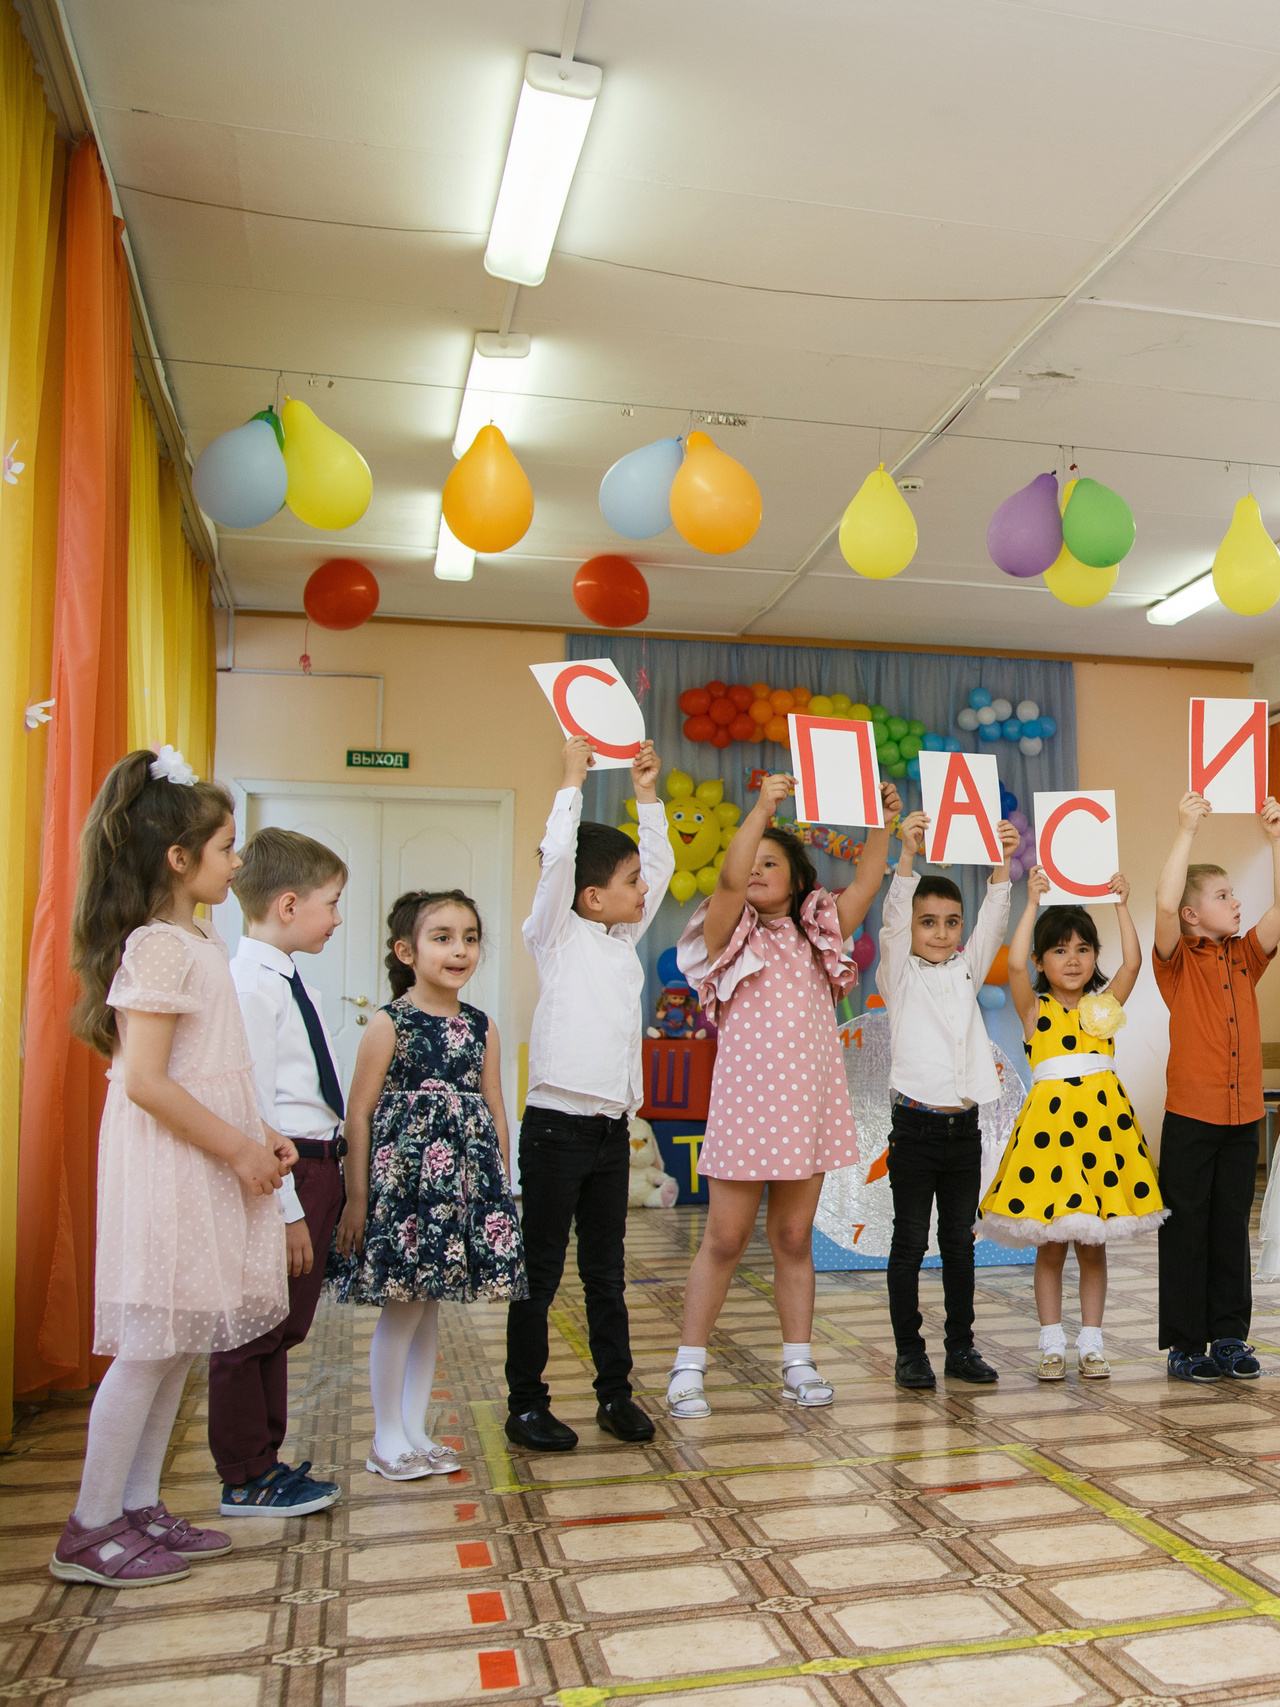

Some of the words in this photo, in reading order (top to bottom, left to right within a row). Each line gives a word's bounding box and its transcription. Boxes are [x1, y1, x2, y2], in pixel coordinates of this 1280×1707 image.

[352, 752, 403, 767] ВЫХОД
[839, 1028, 863, 1049] 11
[651, 1049, 691, 1109] Ш
[851, 1224, 866, 1244] 7
